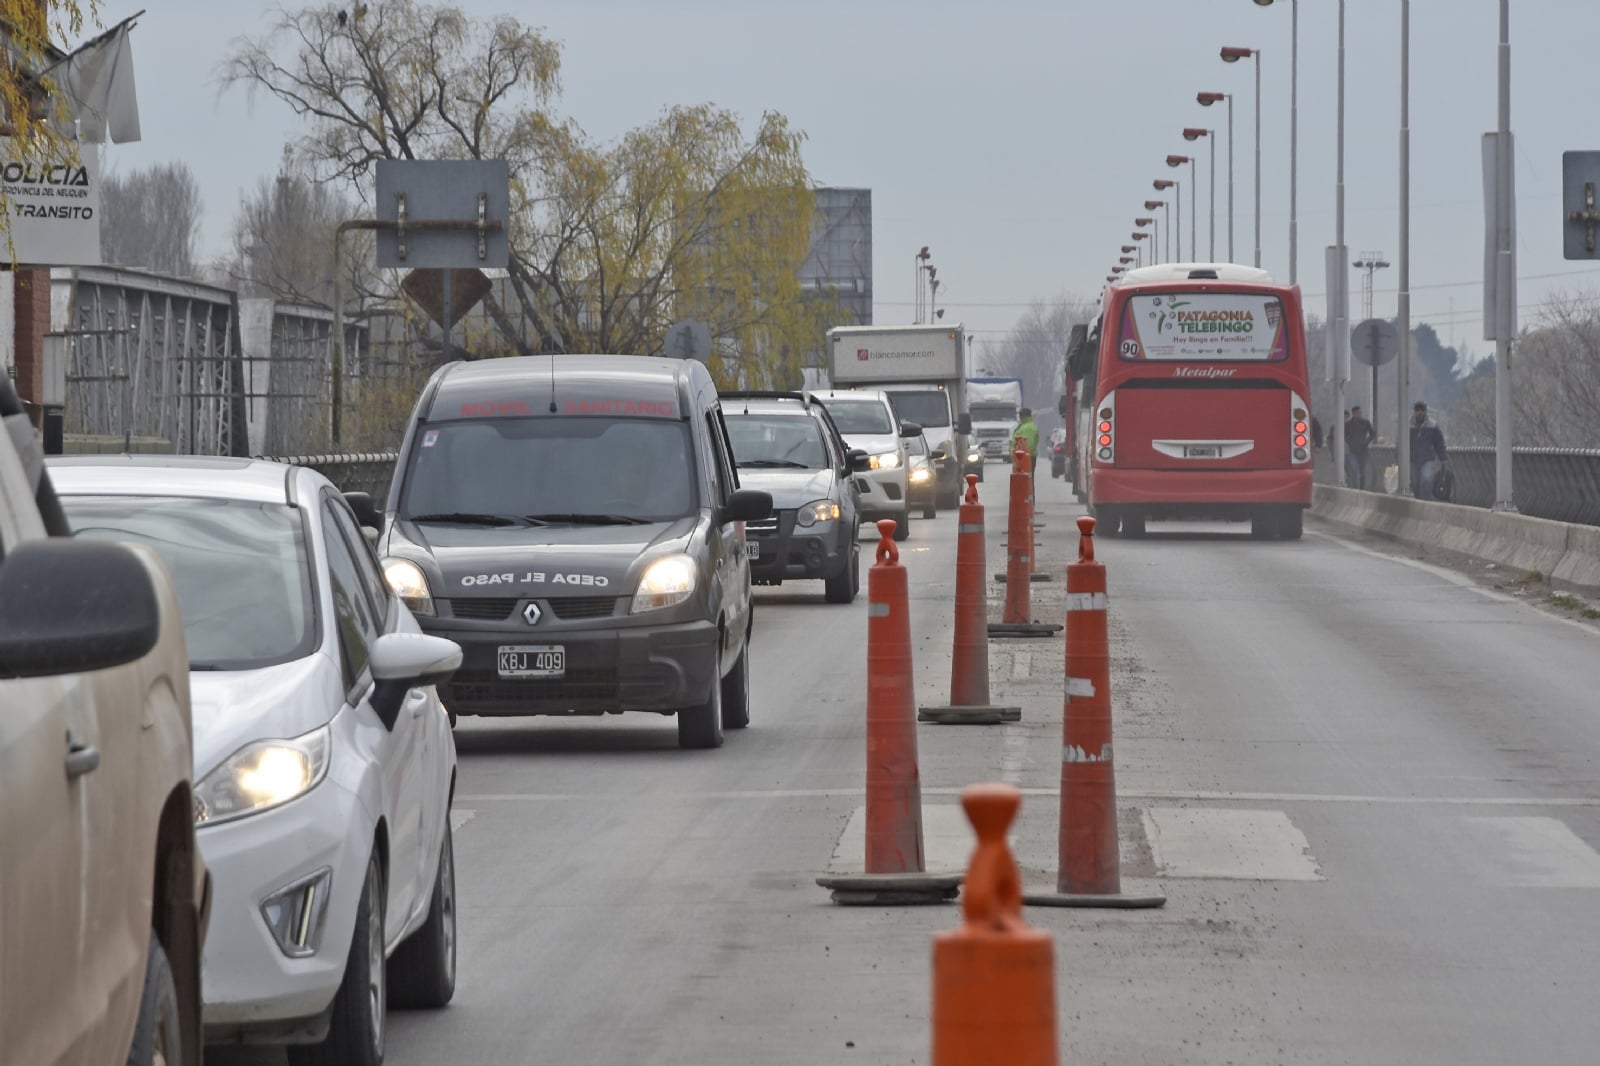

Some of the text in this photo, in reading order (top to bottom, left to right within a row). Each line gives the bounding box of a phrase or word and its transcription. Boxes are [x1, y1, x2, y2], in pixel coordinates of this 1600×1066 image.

[0, 162, 89, 186] OLICIA
[41, 188, 55, 197] DEL
[15, 204, 93, 220] TRANSITO
[1177, 310, 1254, 322] PATAGONIA
[1178, 321, 1253, 333] TELEBINGO
[1122, 342, 1138, 356] 90
[1172, 366, 1237, 378] Metalpar
[460, 399, 673, 417] MOVIL SANITARIO
[500, 652, 563, 670] KBJ 409
